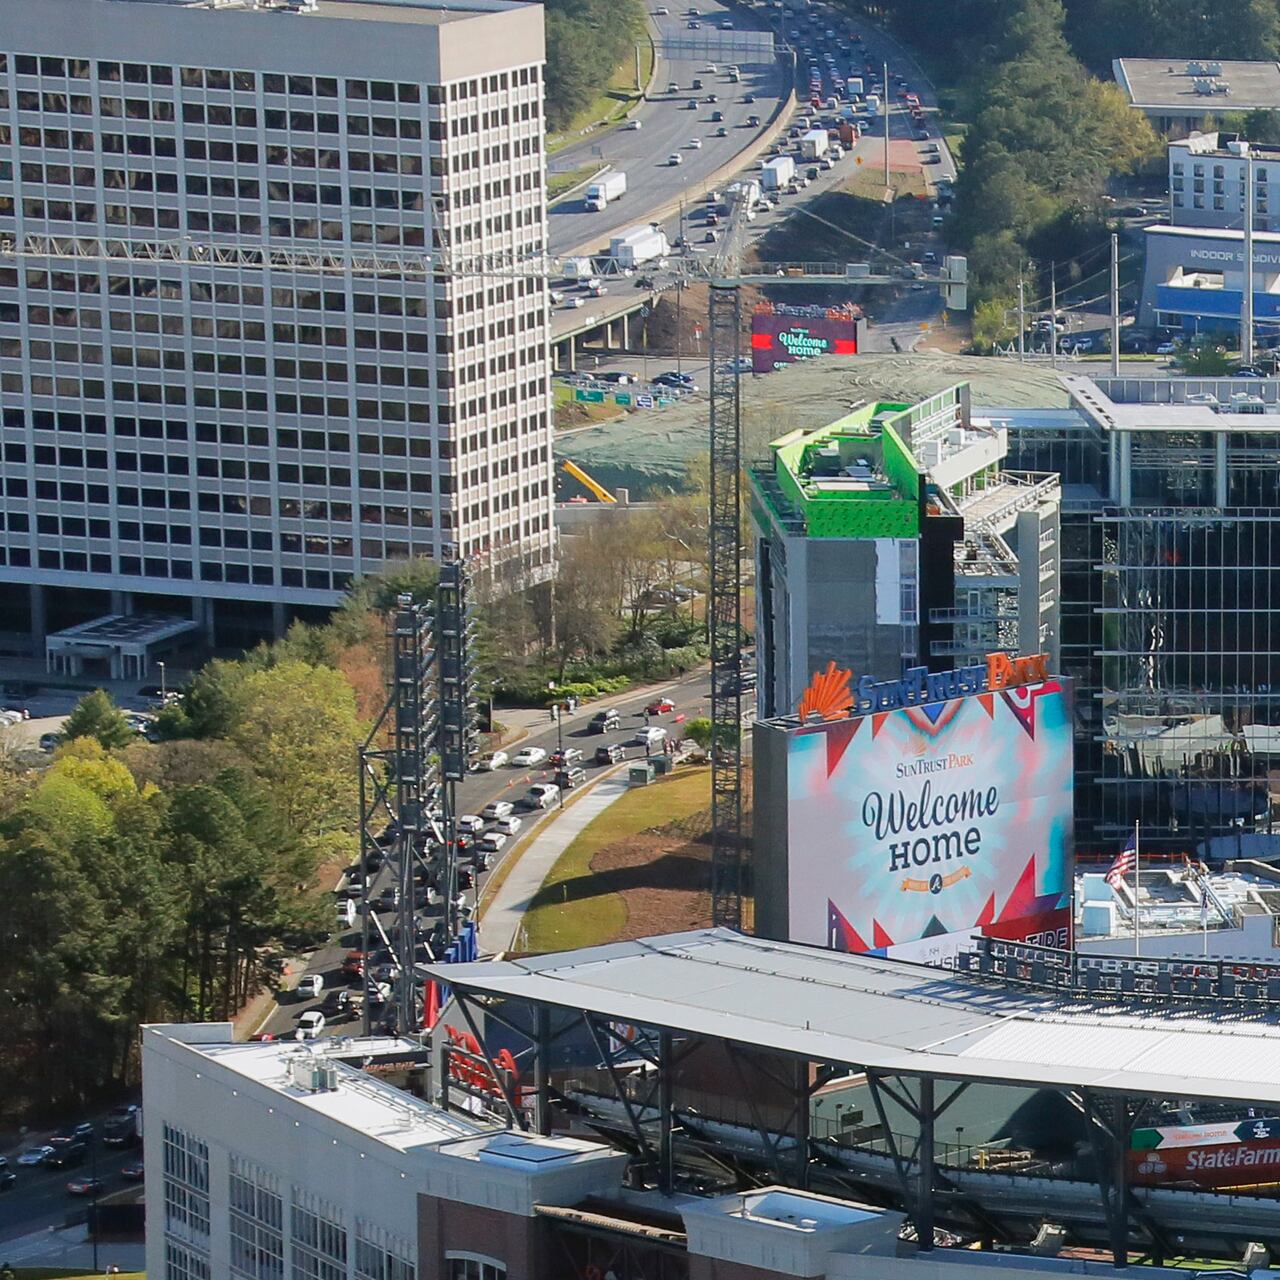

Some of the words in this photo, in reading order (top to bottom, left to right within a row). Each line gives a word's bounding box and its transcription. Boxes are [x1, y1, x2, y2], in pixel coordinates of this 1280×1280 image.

[1190, 249, 1234, 260] INDOOR
[778, 332, 829, 348] Welcome
[862, 779, 1000, 841] Welcome
